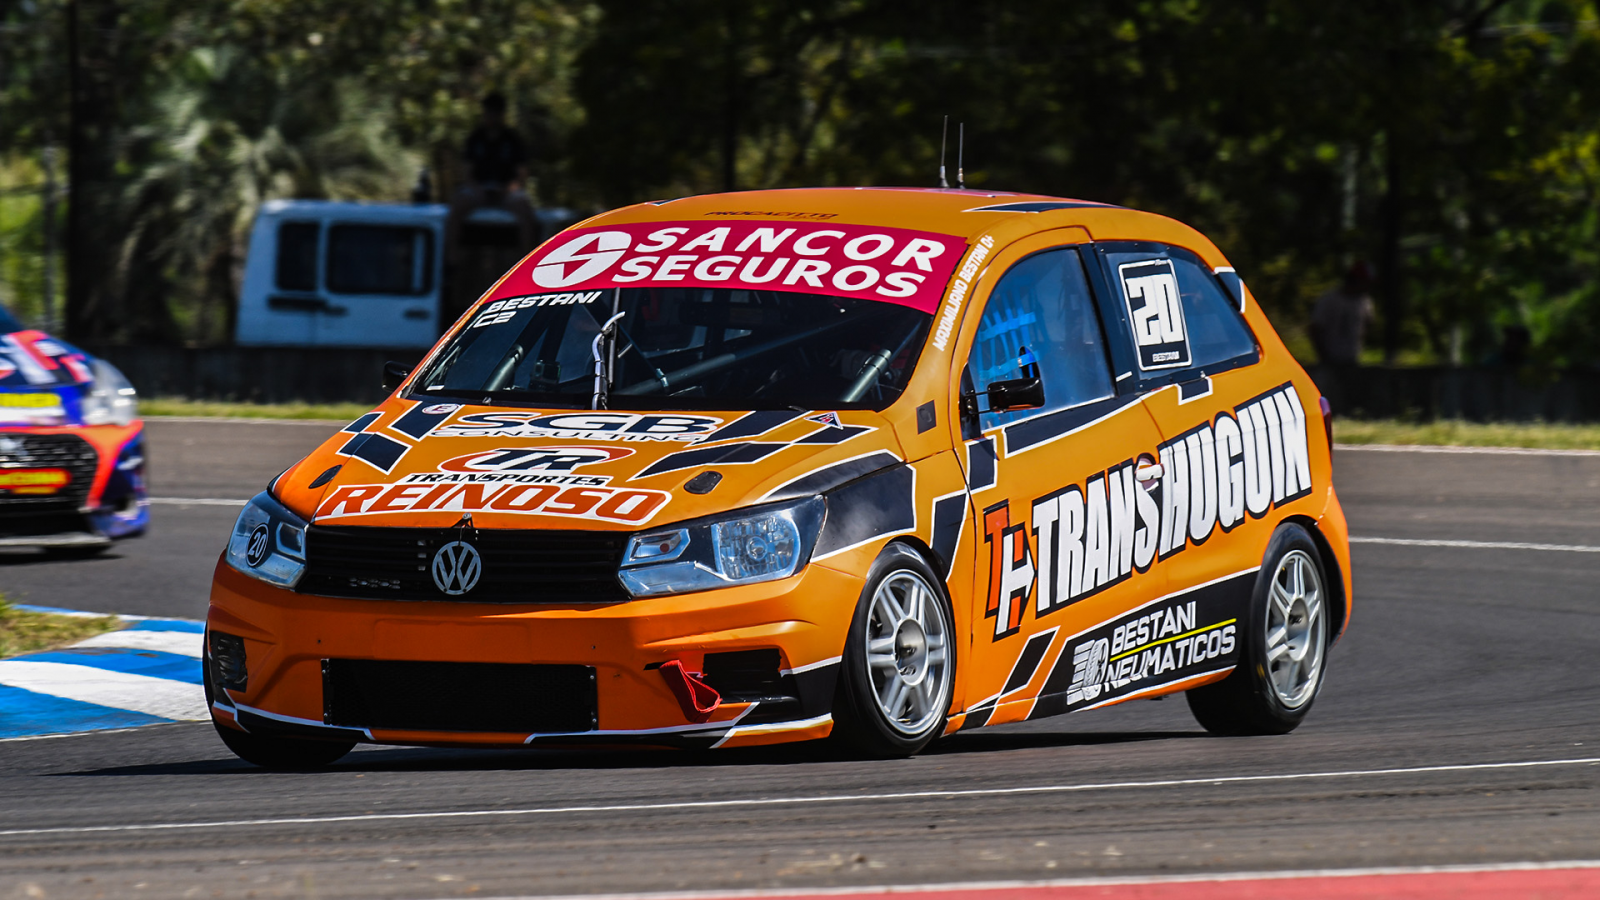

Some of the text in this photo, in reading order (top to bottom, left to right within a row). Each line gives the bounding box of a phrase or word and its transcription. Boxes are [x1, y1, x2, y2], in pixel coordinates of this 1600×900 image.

[634, 226, 946, 272] SANCOR
[611, 254, 926, 298] SEGUROS
[483, 291, 603, 315] BESTANI
[932, 278, 969, 352] MAXIMILIANO
[958, 242, 990, 284] BESTANI
[1125, 273, 1185, 346] 20
[473, 310, 517, 328] C2
[430, 429, 709, 442] CONSULTING
[449, 413, 718, 434] SGB
[406, 473, 608, 486] TRANSPORTES
[1031, 384, 1312, 614] TRANSHUGUIN
[315, 483, 667, 522] REINOSO
[248, 531, 267, 558] 20
[1111, 601, 1197, 656] BESTANI
[1105, 625, 1236, 692] NEUMATICOS
